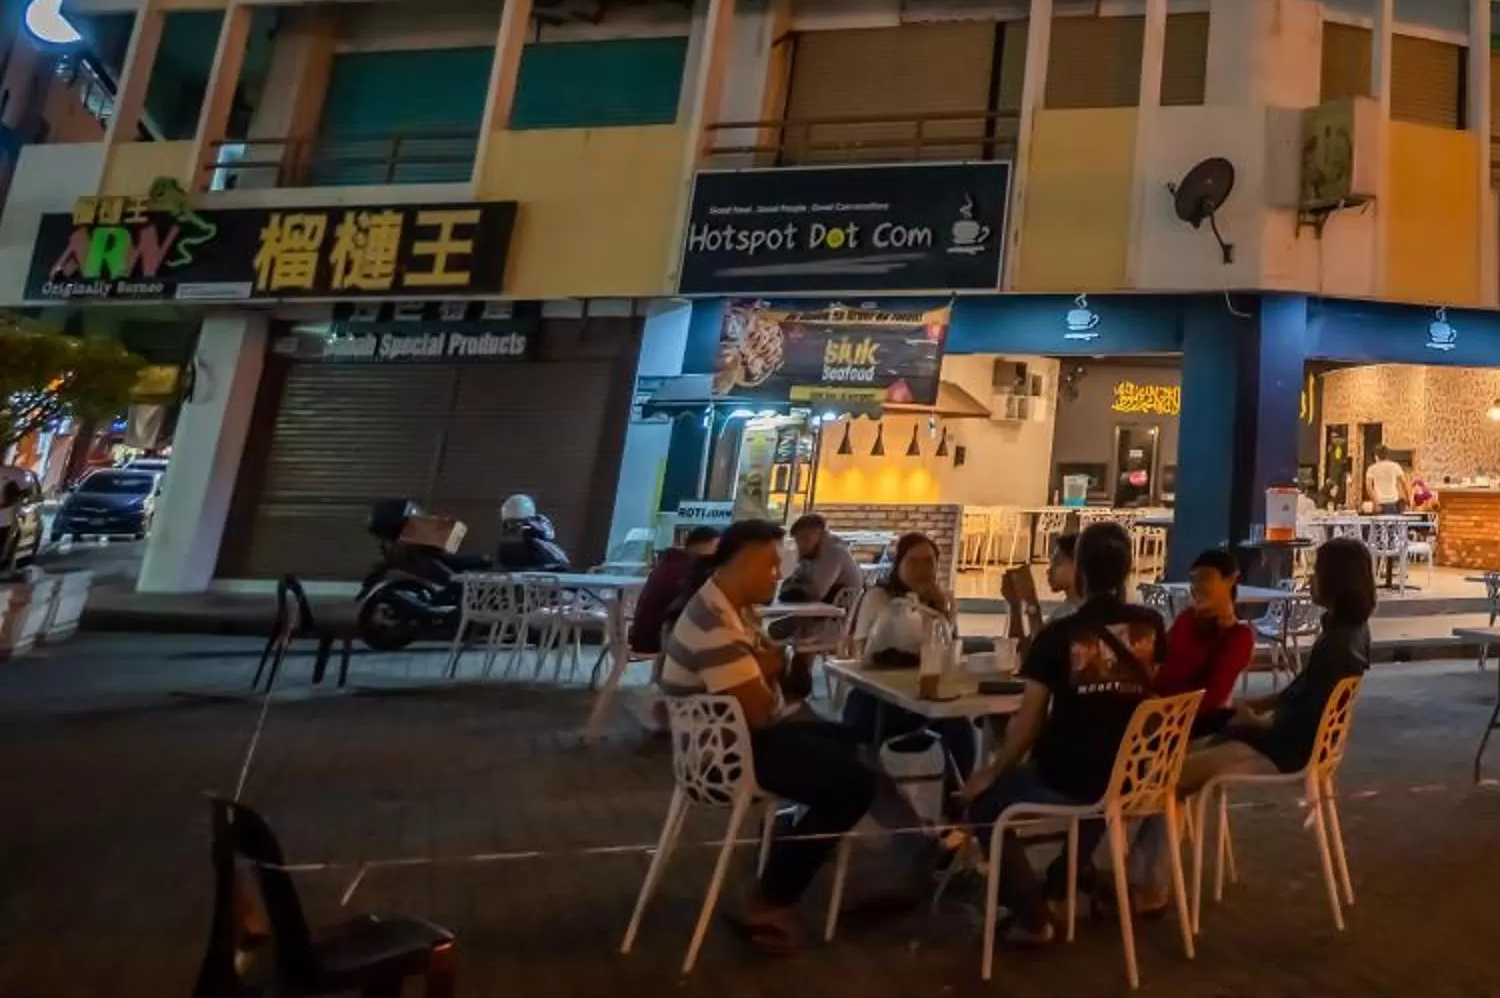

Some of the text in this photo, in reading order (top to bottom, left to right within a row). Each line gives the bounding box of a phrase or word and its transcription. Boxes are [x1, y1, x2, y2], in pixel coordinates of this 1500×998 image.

[688, 221, 932, 255] Hotspot Dot Com
[378, 333, 446, 359] Special
[447, 330, 527, 355] Products
